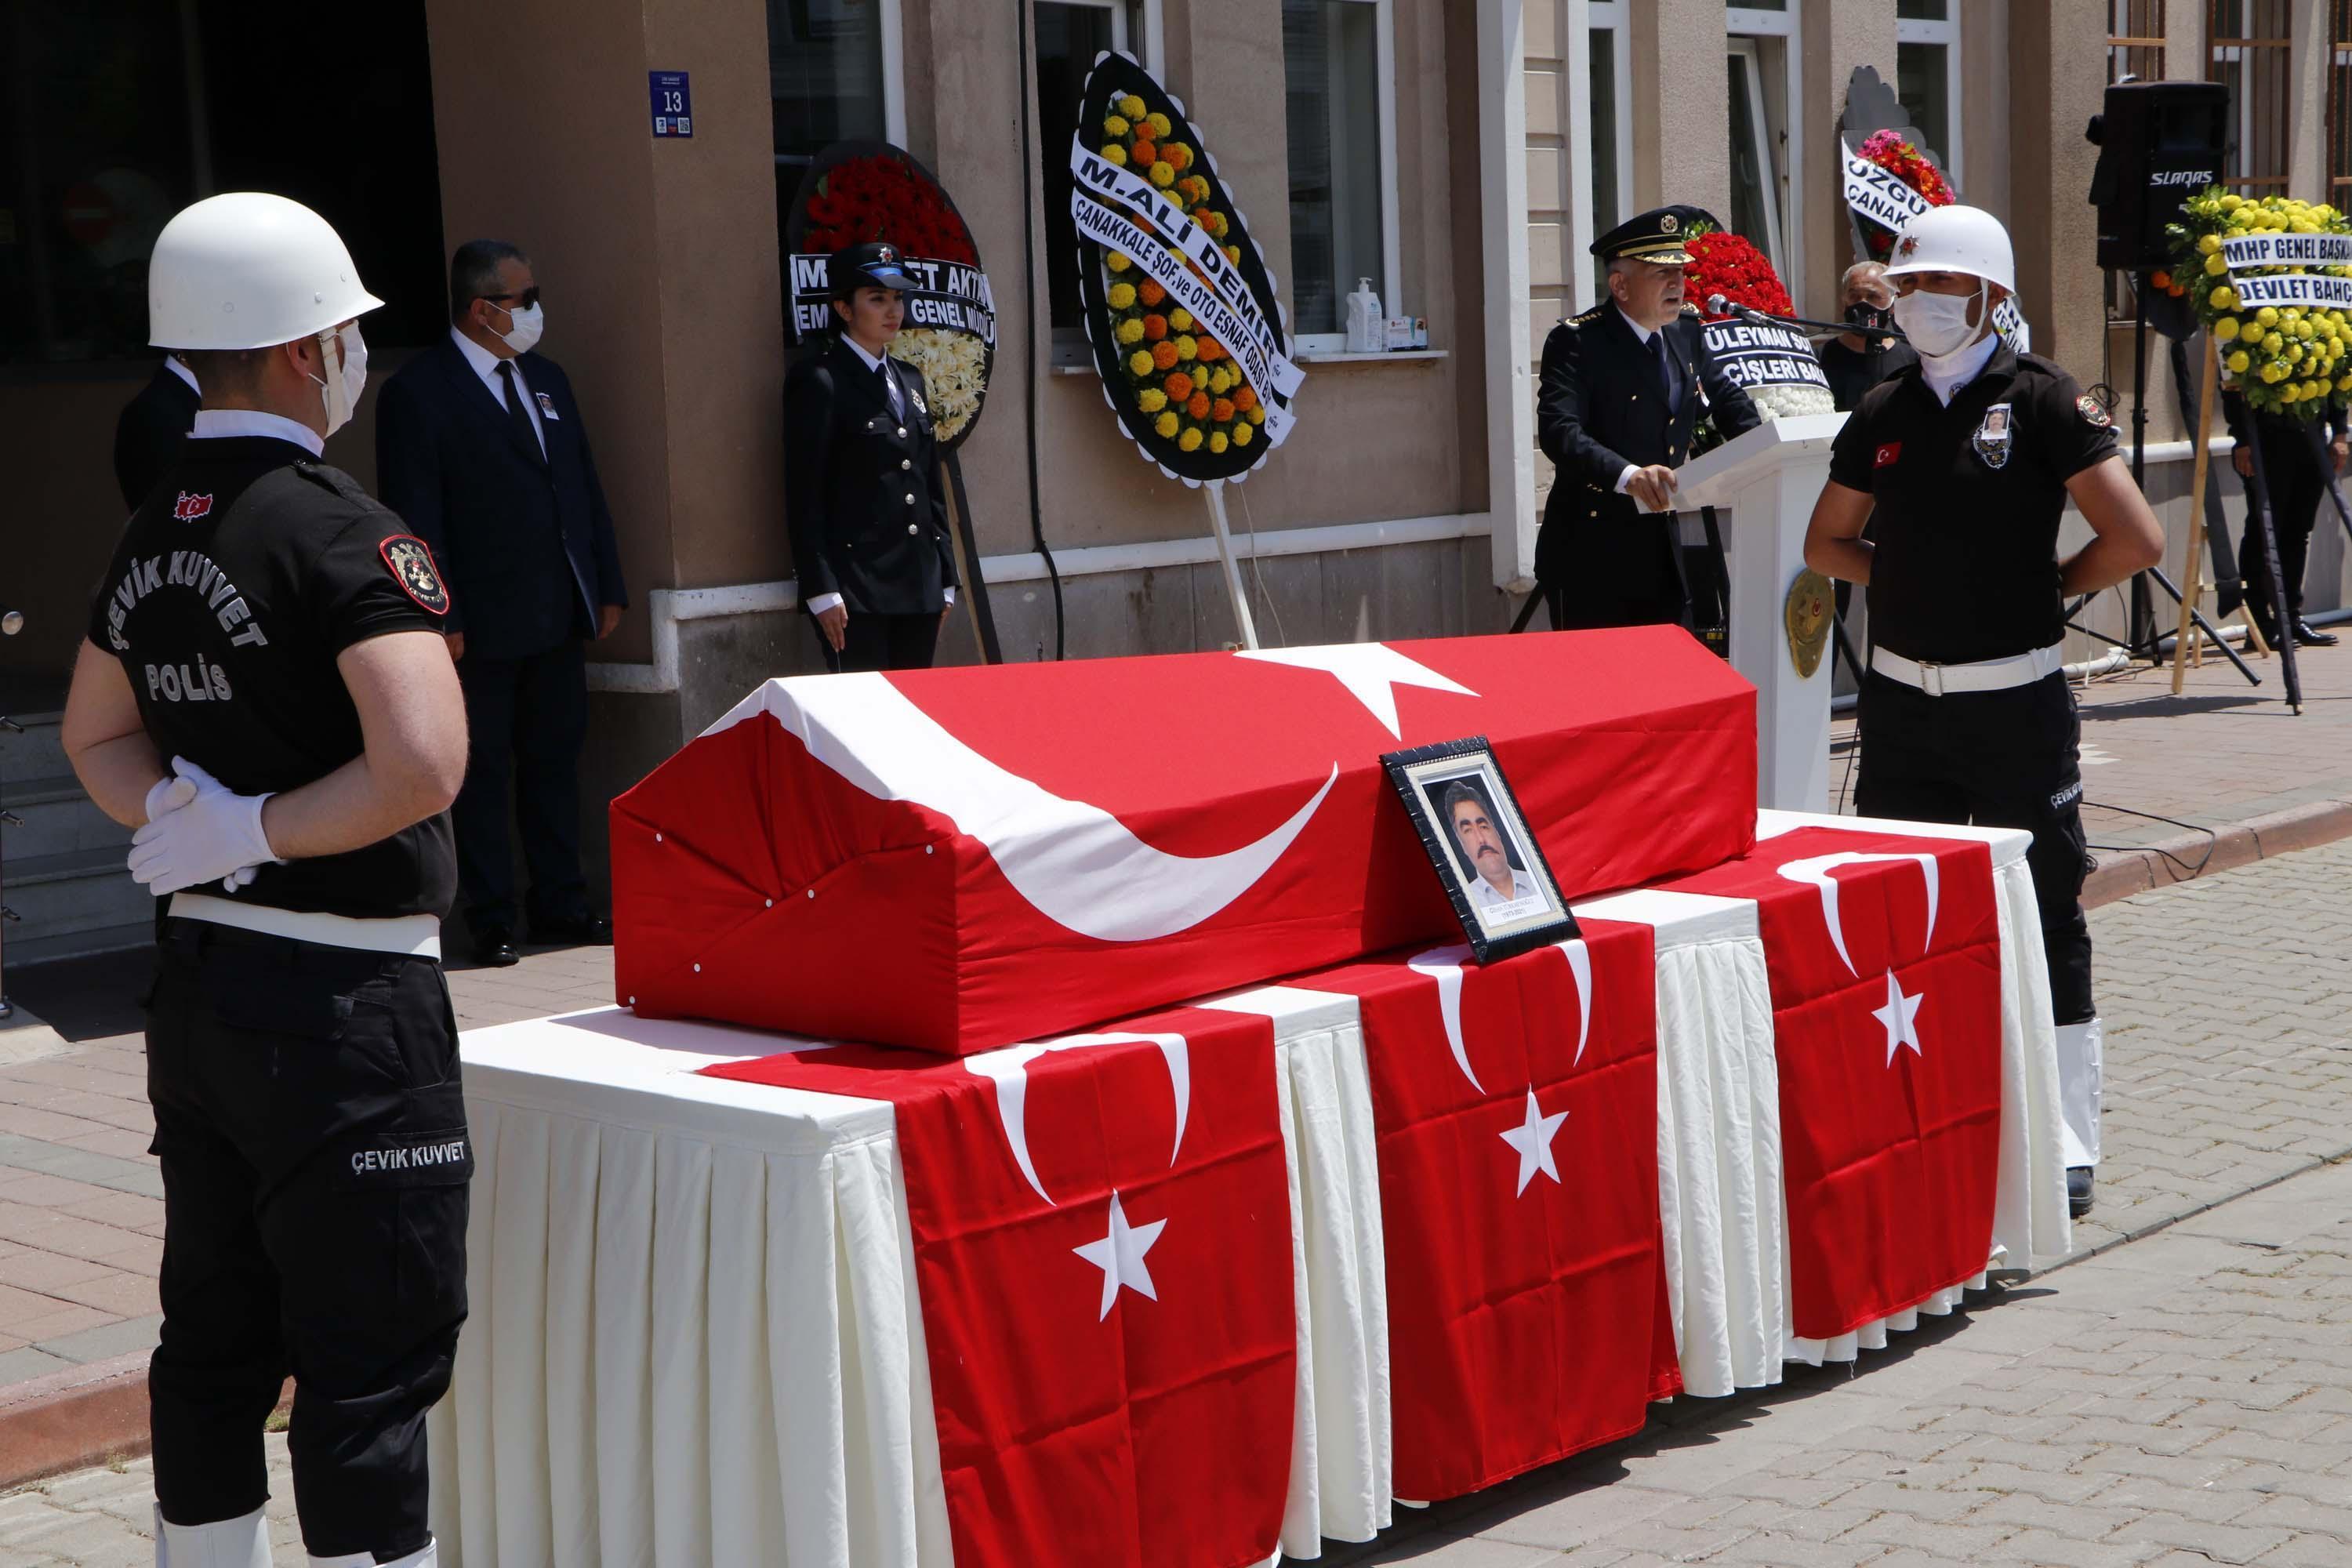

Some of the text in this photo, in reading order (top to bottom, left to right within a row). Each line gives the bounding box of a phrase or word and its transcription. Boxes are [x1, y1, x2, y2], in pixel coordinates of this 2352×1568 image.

[664, 91, 682, 112] 13
[1849, 161, 1927, 216] ÖZGÜ
[1849, 184, 1909, 229] ÇANAK
[2225, 239, 2270, 263] MHP
[2275, 238, 2315, 260] GENEL
[1076, 199, 1156, 262] ÇANAKKALE
[1213, 308, 1250, 353] ESNAF
[1245, 346, 1265, 390] ODASI
[1200, 243, 1275, 363] DEMİR
[2238, 279, 2352, 307] DEVLET BAHÇ
[911, 298, 965, 328] GENEL
[1704, 326, 1792, 352] ÜLEYMAN
[1722, 355, 1800, 387] ÇİŞLERİ
[107, 550, 268, 652] ÇEVİK KUVVET
[145, 652, 233, 702] POLİS
[351, 1141, 465, 1175] ÇEVİK KUVVET
